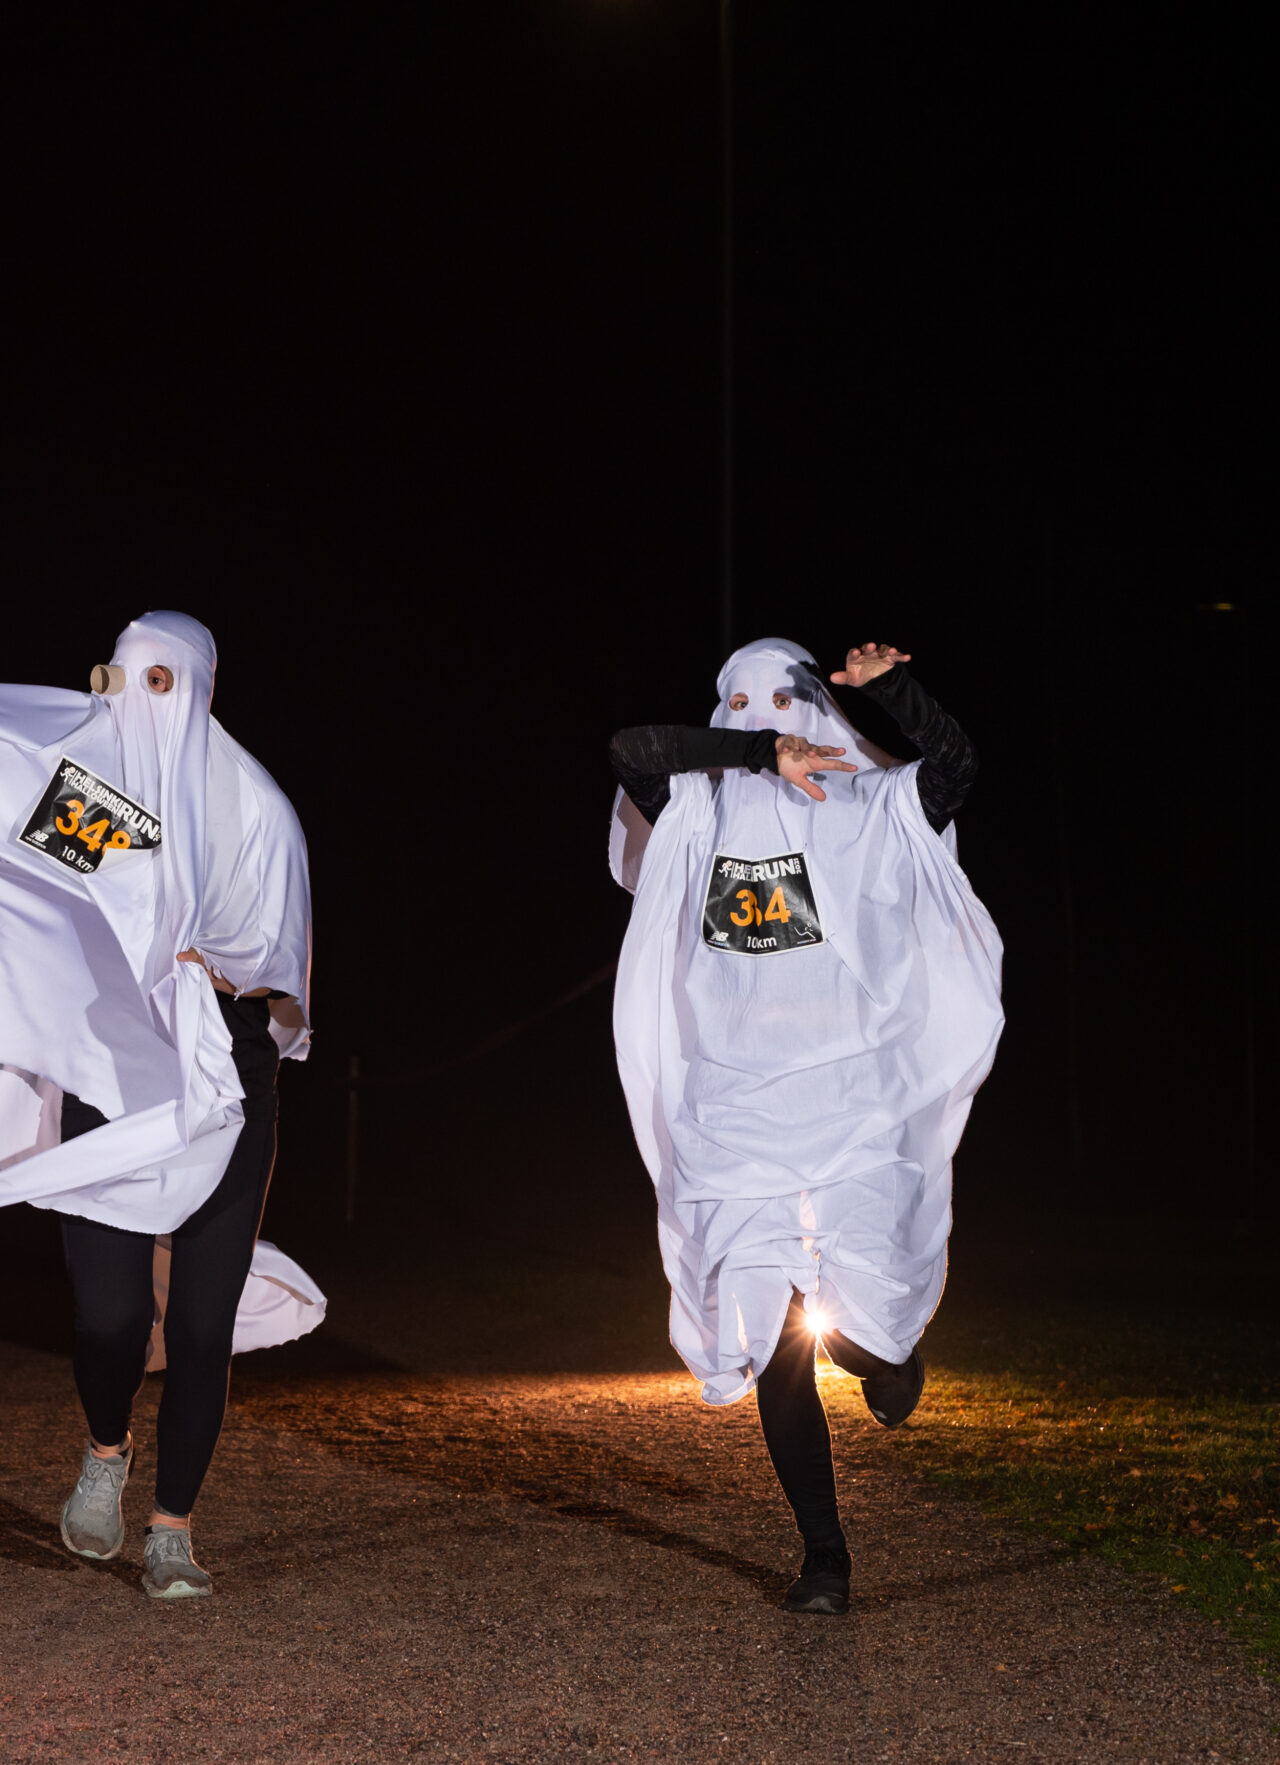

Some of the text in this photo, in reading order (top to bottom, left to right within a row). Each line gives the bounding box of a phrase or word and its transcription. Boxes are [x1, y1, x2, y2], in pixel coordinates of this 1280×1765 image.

[71, 781, 119, 815] HALLOWEEN
[73, 770, 159, 841] HELSINKI RUN
[61, 846, 74, 862] 10
[76, 856, 95, 873] km
[752, 858, 796, 882] RUN
